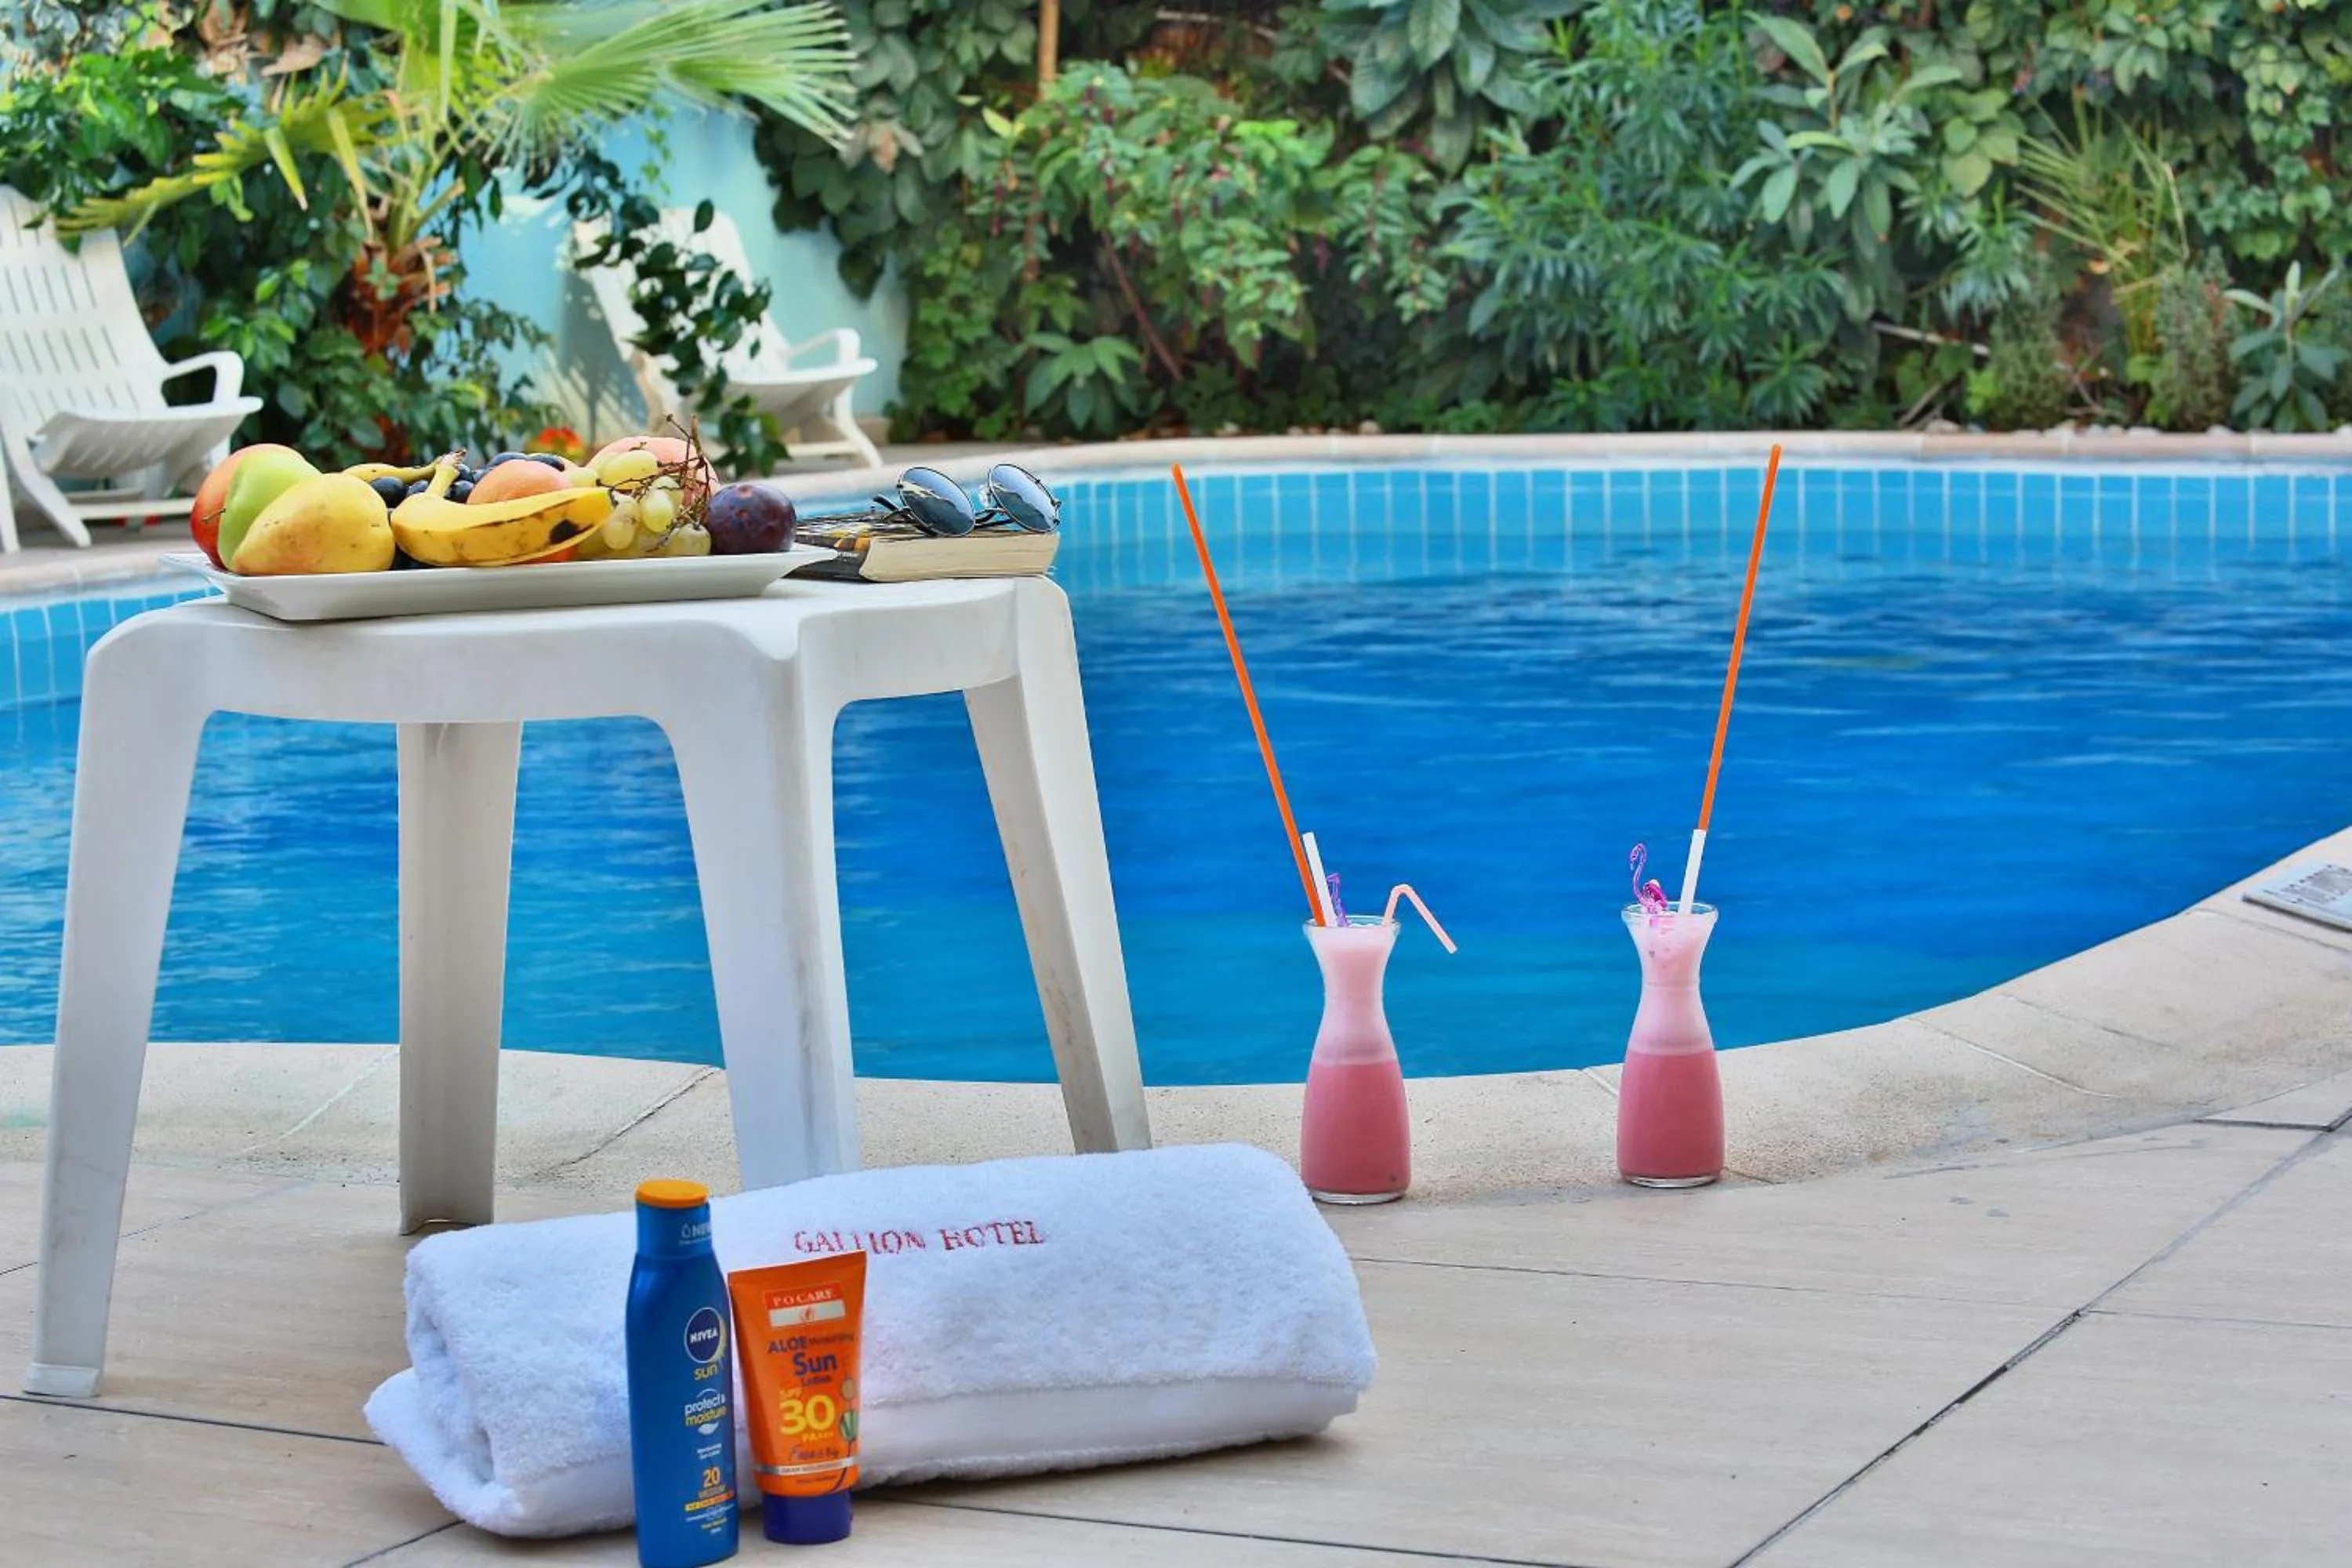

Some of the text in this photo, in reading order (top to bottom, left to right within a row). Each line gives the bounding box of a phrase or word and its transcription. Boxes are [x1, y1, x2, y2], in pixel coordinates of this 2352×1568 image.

[937, 1220, 1045, 1250] HOTEL
[690, 1327, 719, 1343] NIVEA
[768, 1335, 808, 1353] ALOE
[693, 1363, 718, 1381] sun
[792, 1351, 838, 1377] Sun
[779, 1387, 803, 1400] SPF
[779, 1394, 835, 1436] 30
[702, 1467, 720, 1487] 20
